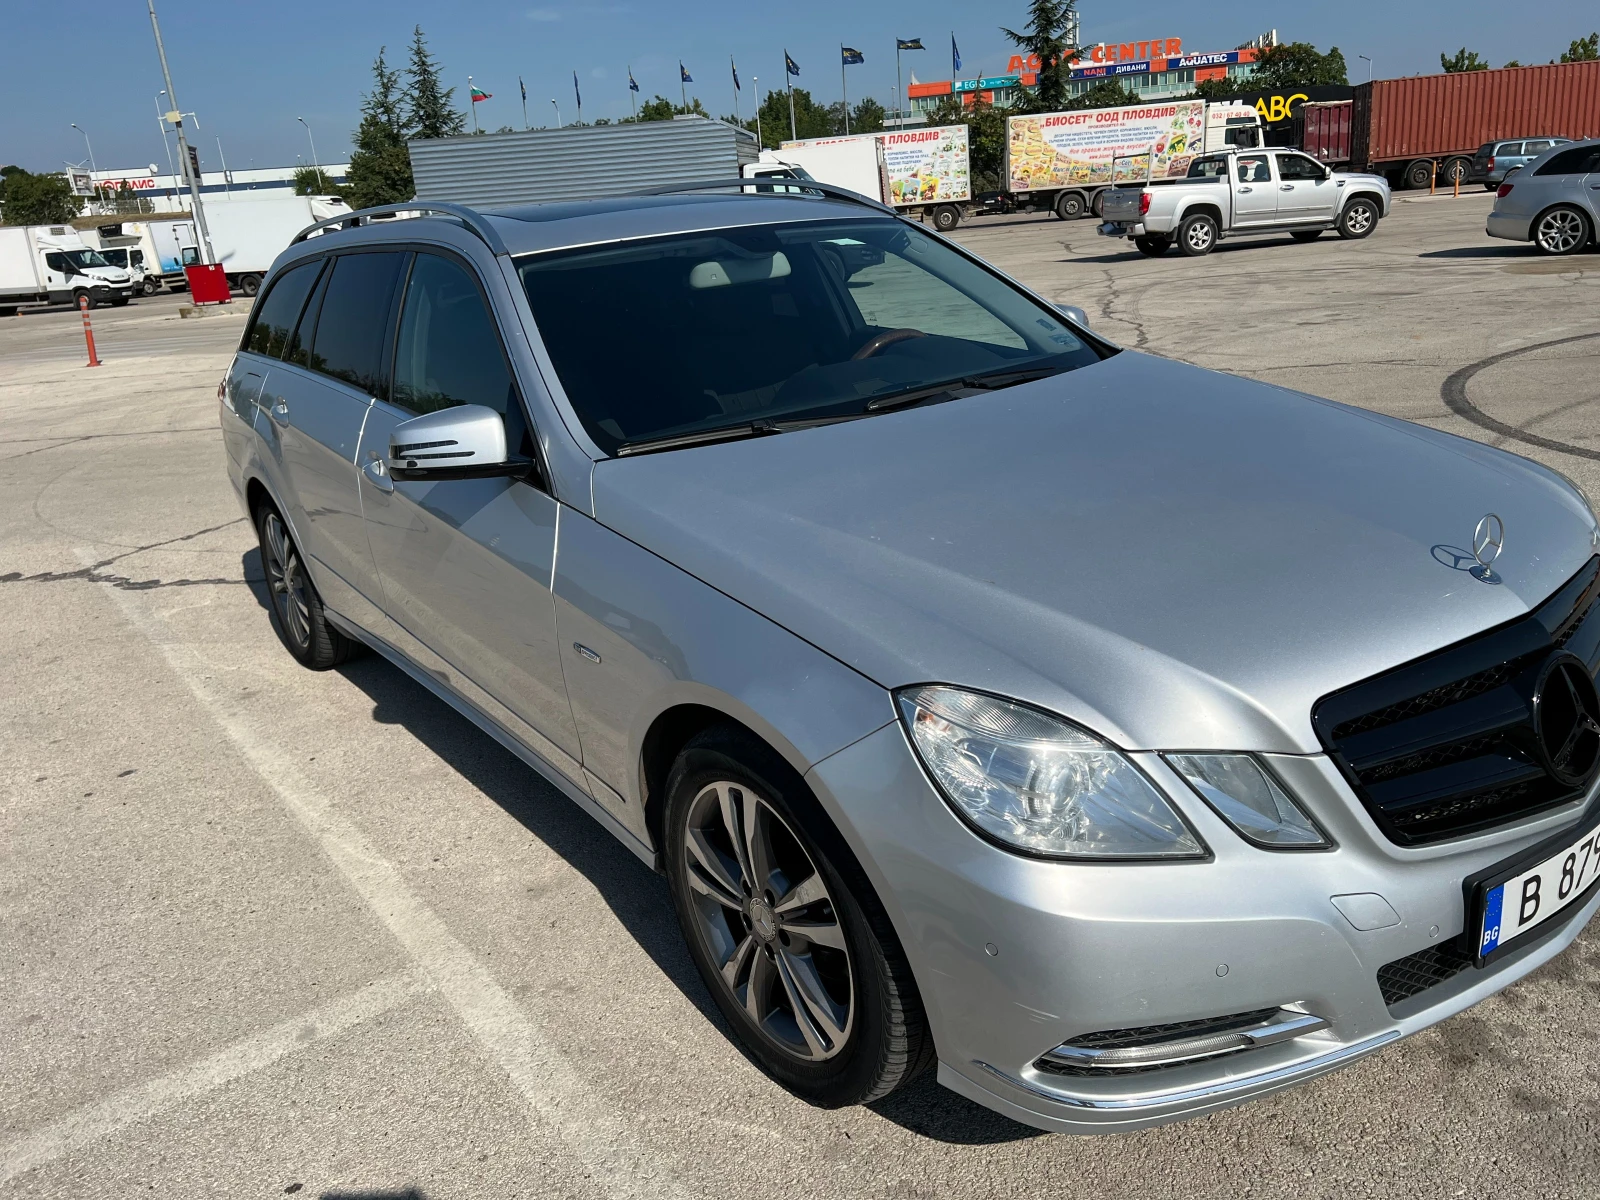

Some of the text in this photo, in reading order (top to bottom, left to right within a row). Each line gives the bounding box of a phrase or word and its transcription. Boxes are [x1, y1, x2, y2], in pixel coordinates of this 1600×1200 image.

[1091, 37, 1182, 63] CENTER
[1178, 53, 1228, 67] AQUATEC
[1083, 68, 1106, 76] NANI
[1115, 64, 1147, 74] ДИВАНИ
[964, 80, 987, 89] EGO
[1096, 111, 1119, 123] ООД
[1122, 107, 1176, 120] ПЛОВДИВ
[1255, 93, 1309, 122] ABC
[889, 131, 939, 144] ПЛОВДИВ
[1518, 874, 1542, 927] B
[1483, 925, 1499, 946] BG
